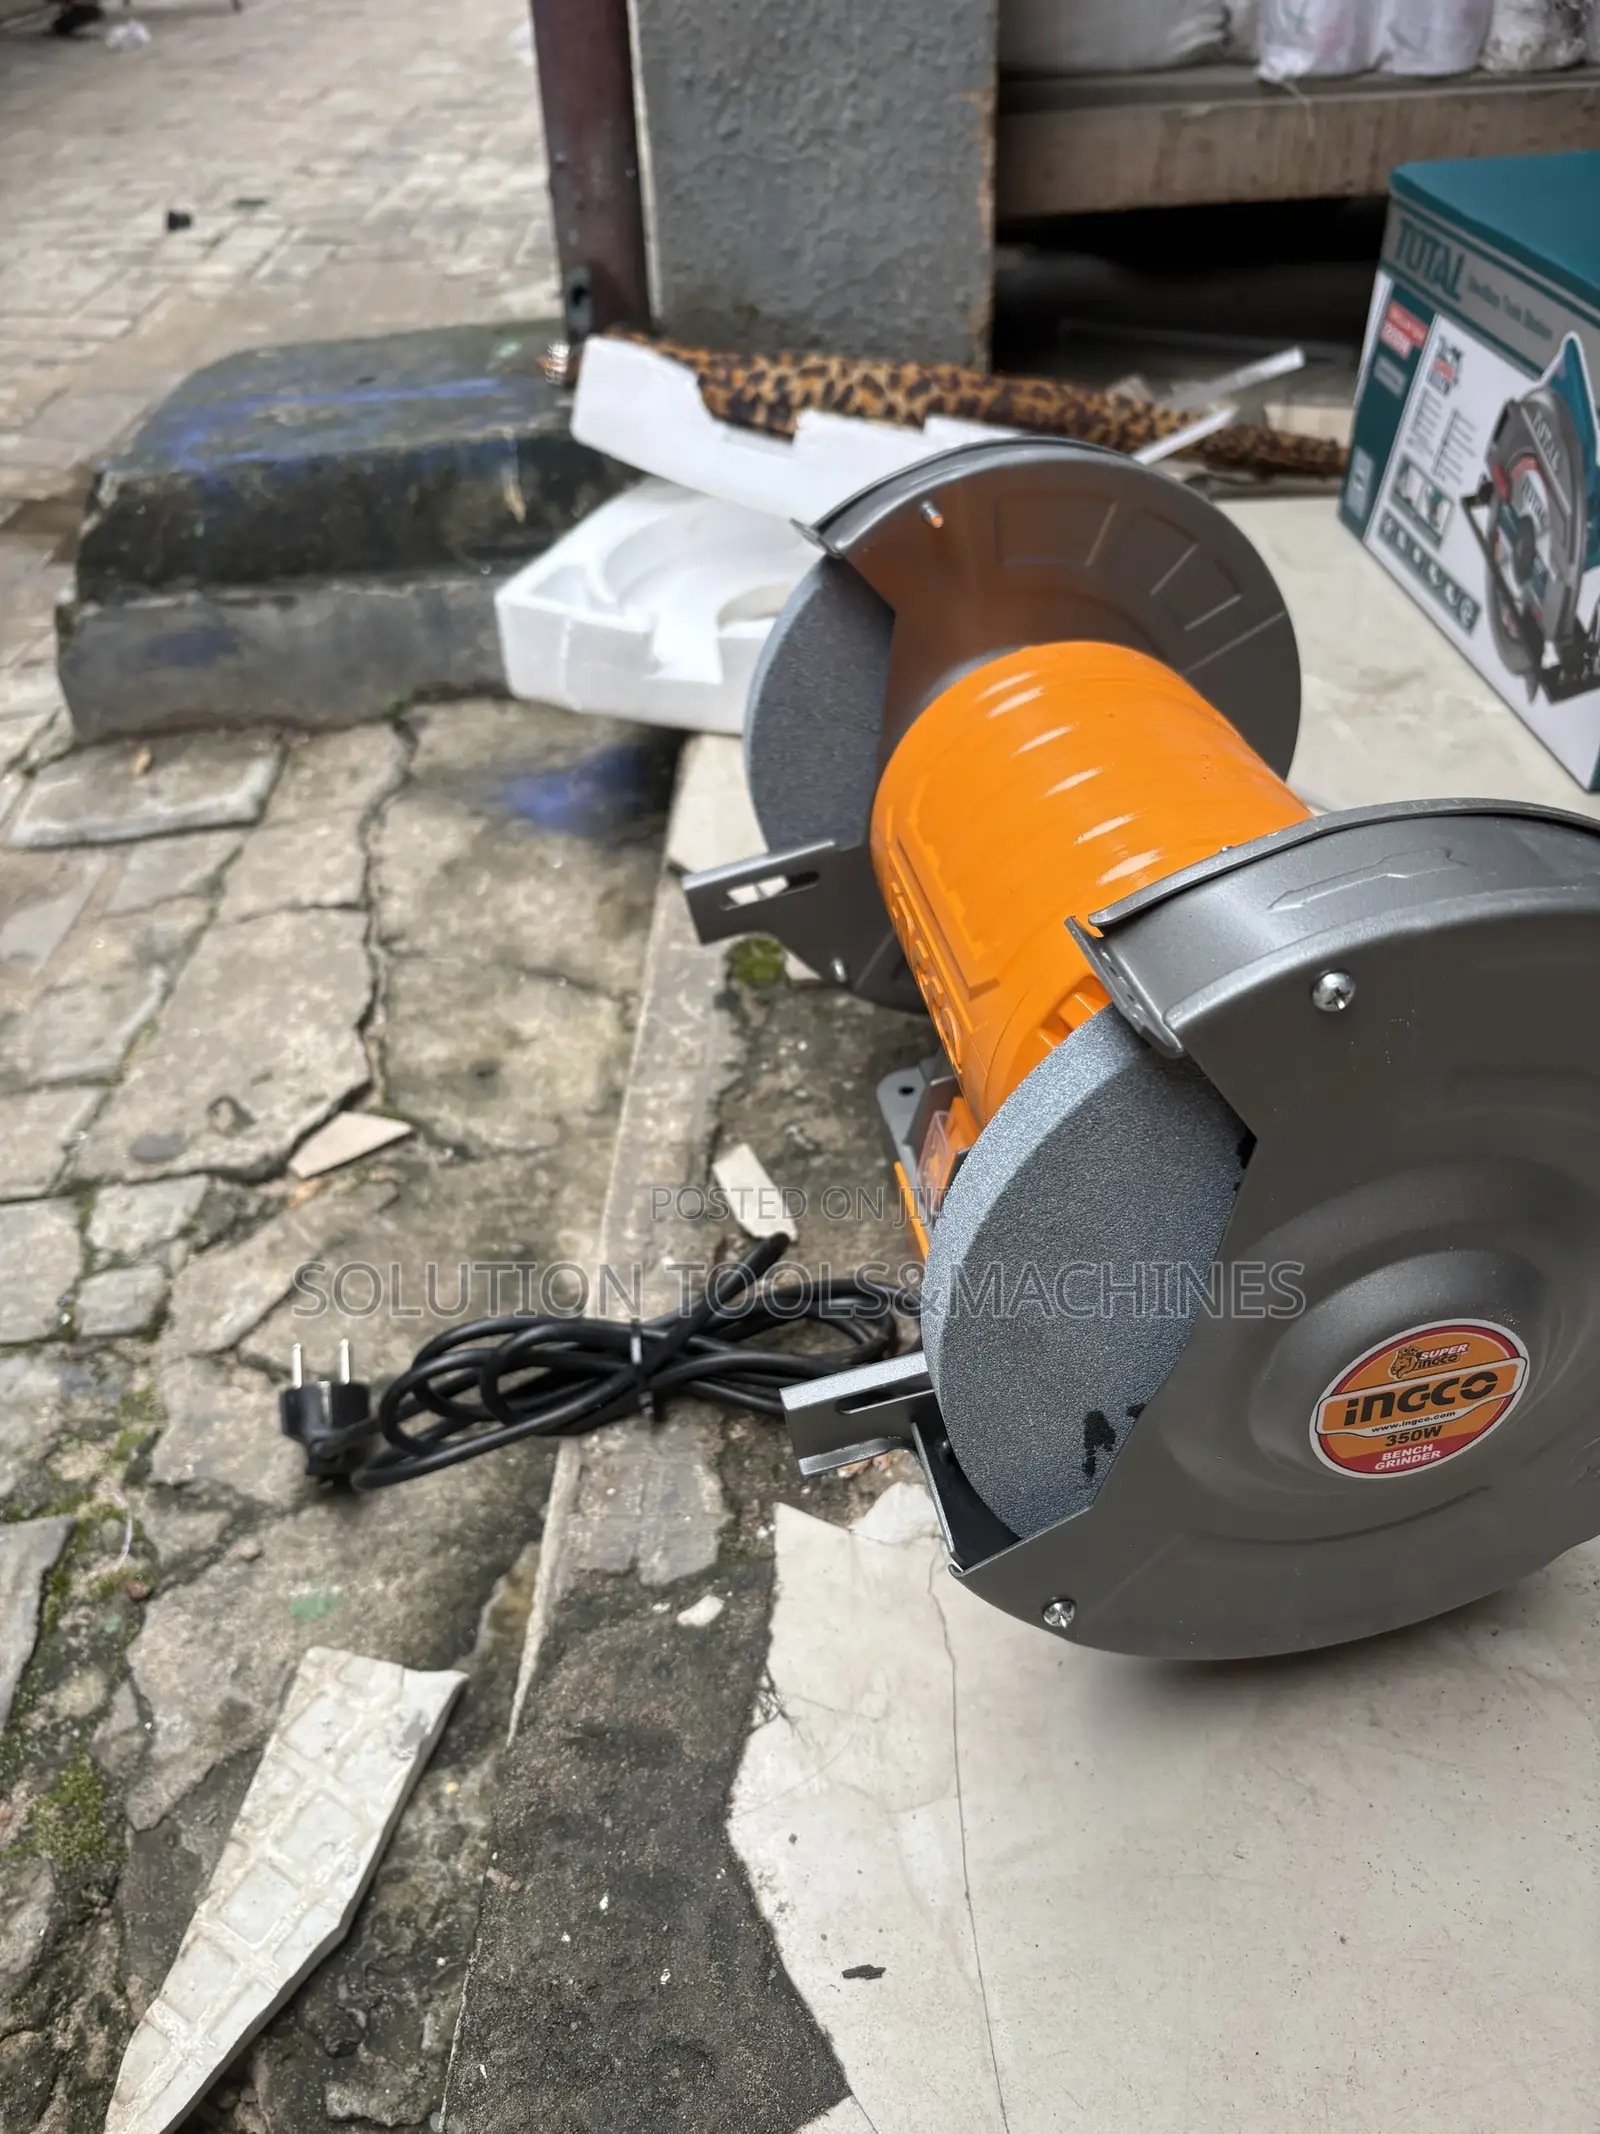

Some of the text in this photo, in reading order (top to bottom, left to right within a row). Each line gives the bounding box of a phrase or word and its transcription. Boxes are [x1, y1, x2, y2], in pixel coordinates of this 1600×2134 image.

[1397, 217, 1466, 303] TOTAL
[1419, 1343, 1470, 1361] SUPER
[1371, 1410, 1456, 1433] www.ingco.com
[1384, 1425, 1443, 1448] 350W
[1374, 1450, 1441, 1471] GRINDER
[1381, 1443, 1434, 1461] BENCH
